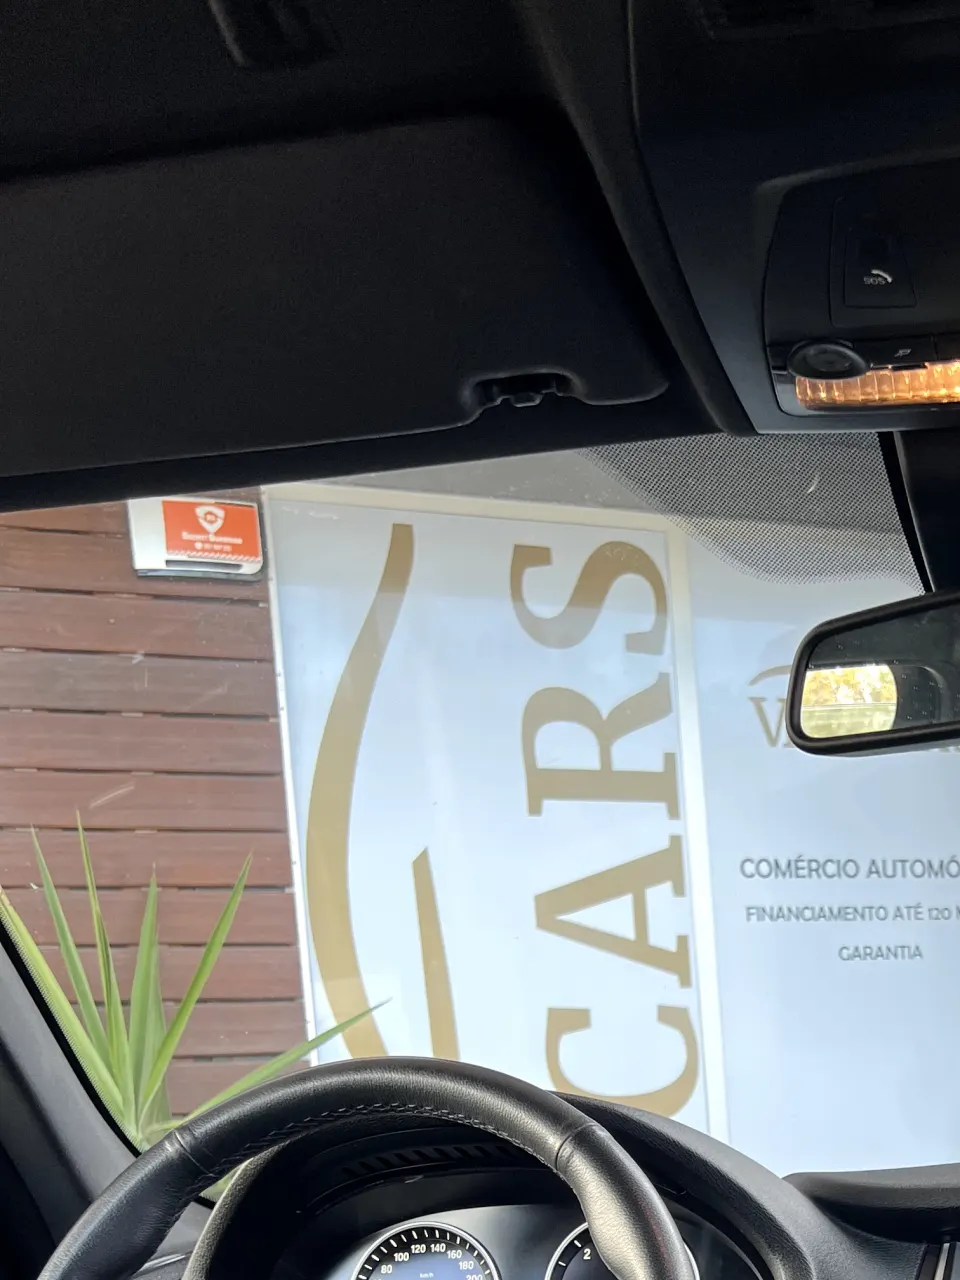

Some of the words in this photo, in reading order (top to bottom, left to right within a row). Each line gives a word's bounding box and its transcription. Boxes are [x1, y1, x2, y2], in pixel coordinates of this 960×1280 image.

[509, 540, 701, 1117] CARS
[739, 854, 860, 880] COMÉRCIO
[745, 905, 889, 923] FINANCIAMENTO
[892, 902, 923, 921] ATÉ
[928, 906, 952, 920] 120
[838, 944, 924, 962] GARANTIA
[410, 1243, 427, 1254] 120
[430, 1243, 446, 1253] 140
[393, 1252, 410, 1262] 100
[446, 1249, 463, 1260] 160
[583, 1248, 591, 1260] 2
[380, 1264, 393, 1274] 80
[458, 1260, 474, 1270] 180
